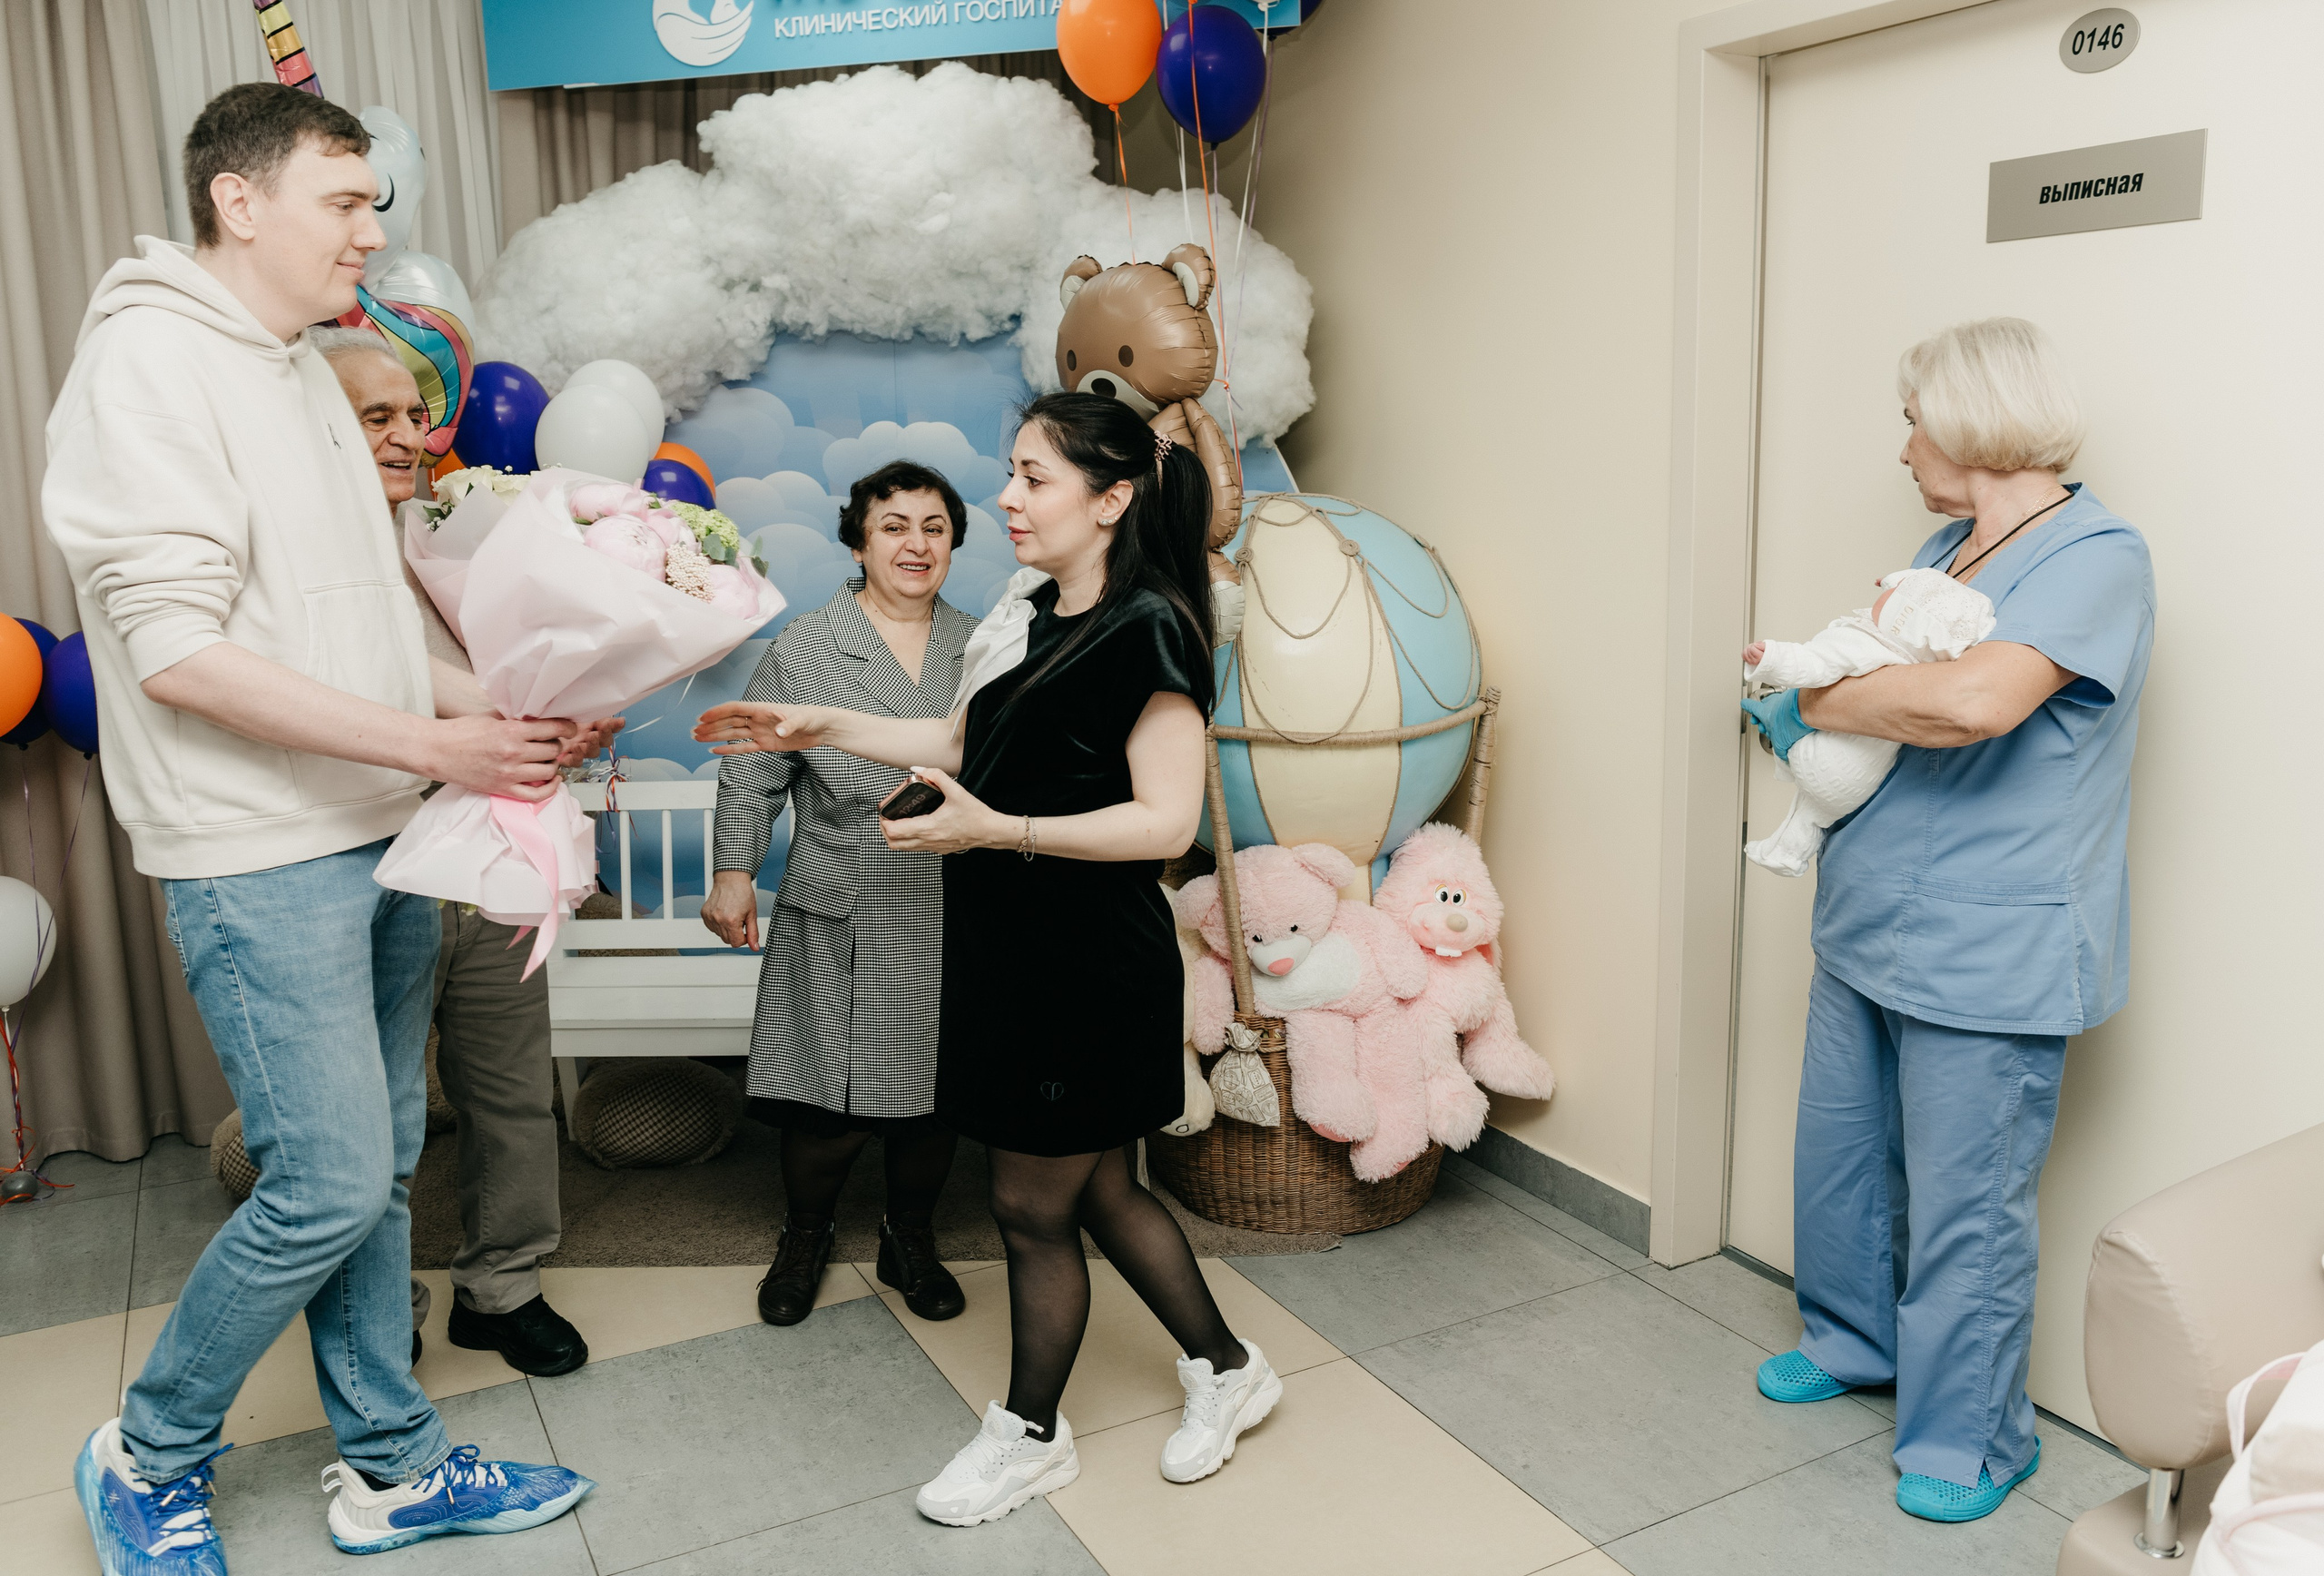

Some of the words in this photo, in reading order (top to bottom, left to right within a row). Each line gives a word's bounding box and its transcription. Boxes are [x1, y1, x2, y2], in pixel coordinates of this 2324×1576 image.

[774, 0, 947, 38] КЛИНИЧЕСКИЙ
[2072, 23, 2125, 55] 0146
[1890, 605, 1915, 636] DIOR
[899, 793, 926, 815] 12:49
